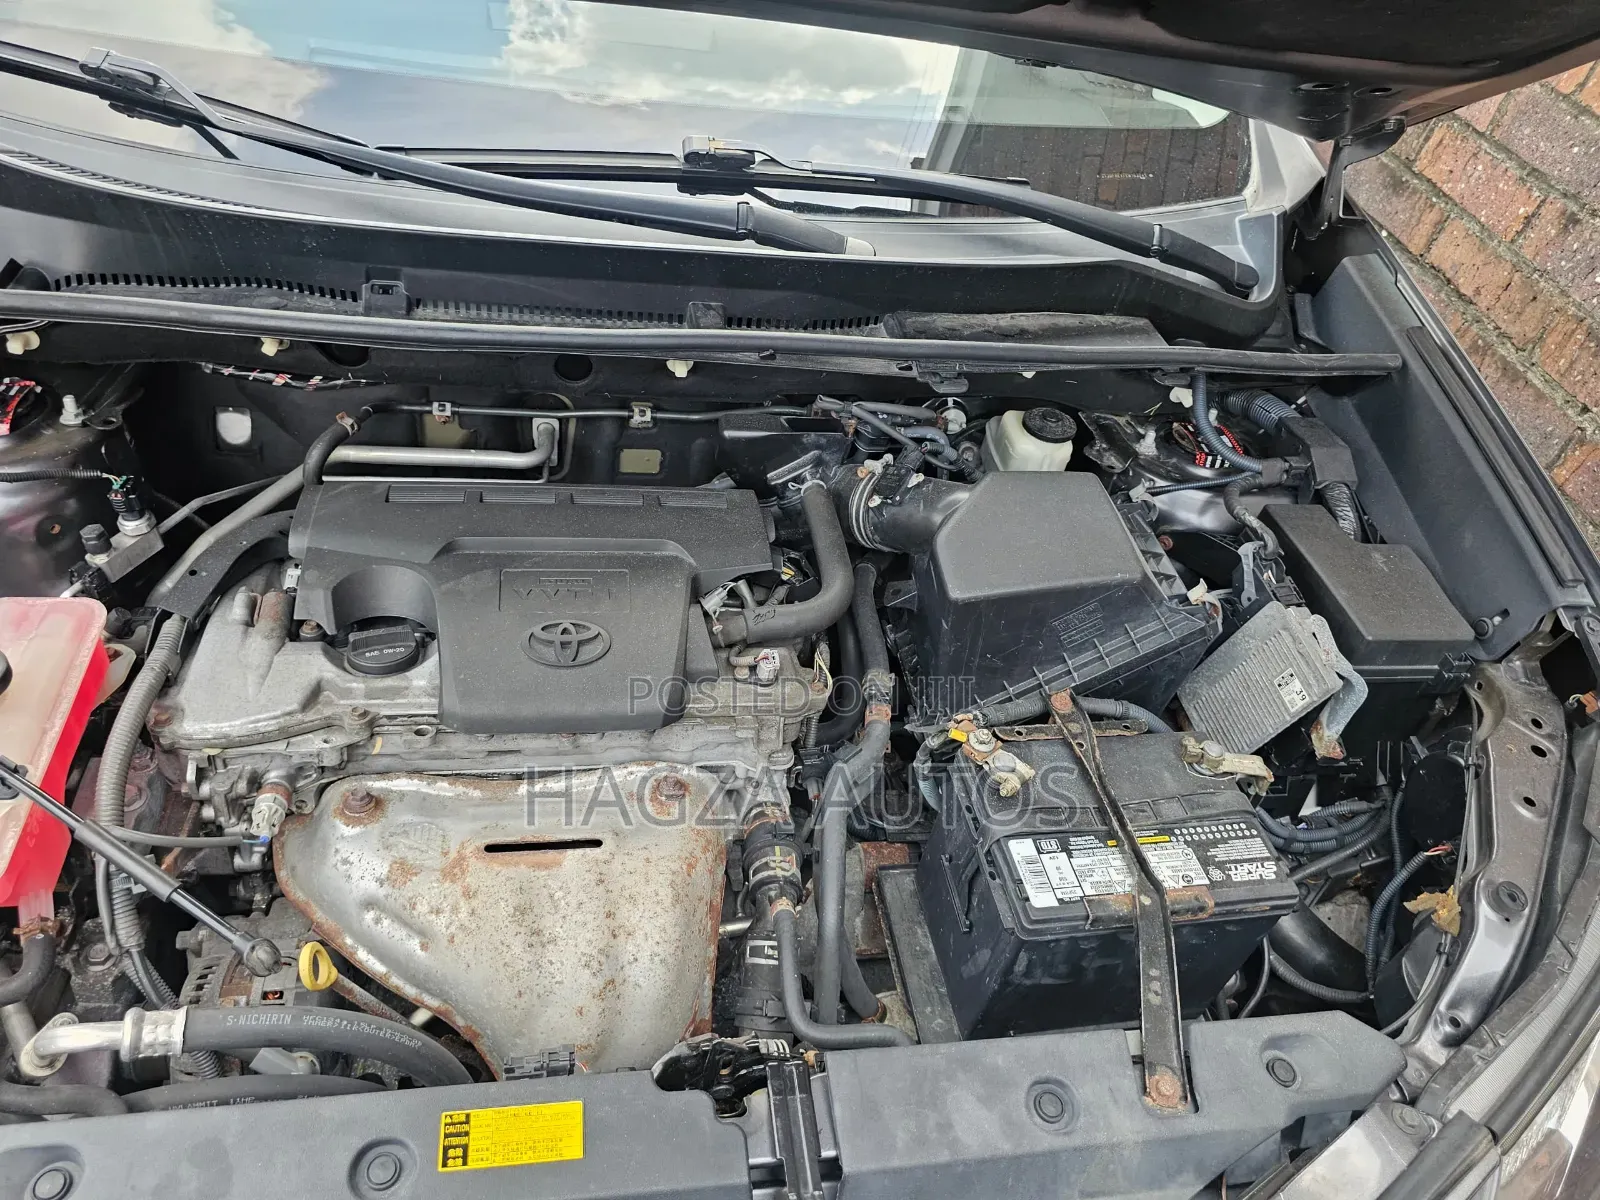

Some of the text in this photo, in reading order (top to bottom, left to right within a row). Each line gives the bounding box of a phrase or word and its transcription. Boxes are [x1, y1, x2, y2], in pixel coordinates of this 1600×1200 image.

[383, 647, 405, 655] 0W-20
[1295, 688, 1307, 702] 39
[1040, 841, 1058, 851] STD
[1231, 869, 1277, 881] SUPER
[444, 1123, 470, 1133] CAUTION
[443, 1136, 469, 1146] ATTENTION
